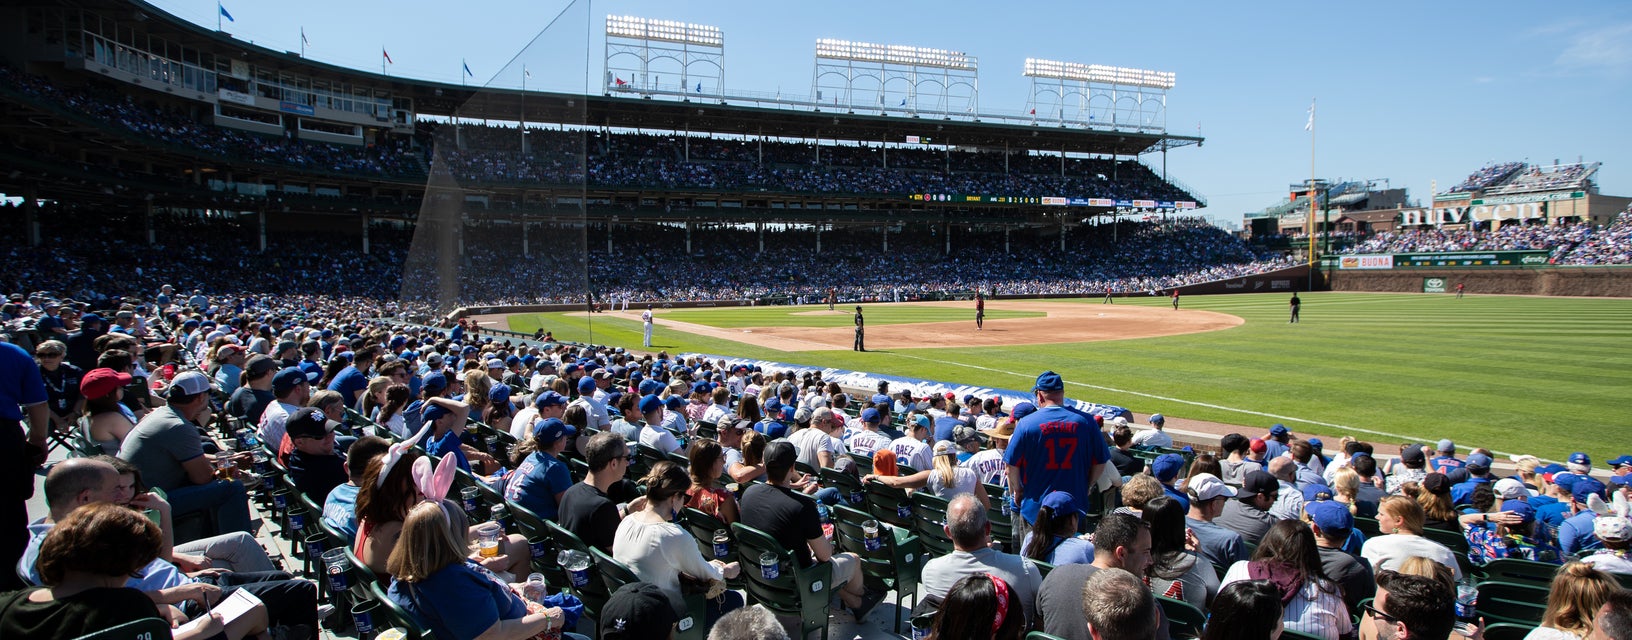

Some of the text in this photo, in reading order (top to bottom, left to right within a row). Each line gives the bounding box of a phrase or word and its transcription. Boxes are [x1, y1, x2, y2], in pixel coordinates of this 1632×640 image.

[1400, 202, 1543, 226] nuveen
[1361, 257, 1390, 267] BUONA
[1039, 420, 1080, 435] BRYANT
[853, 438, 876, 449] RIZZO
[1044, 438, 1078, 470] 17
